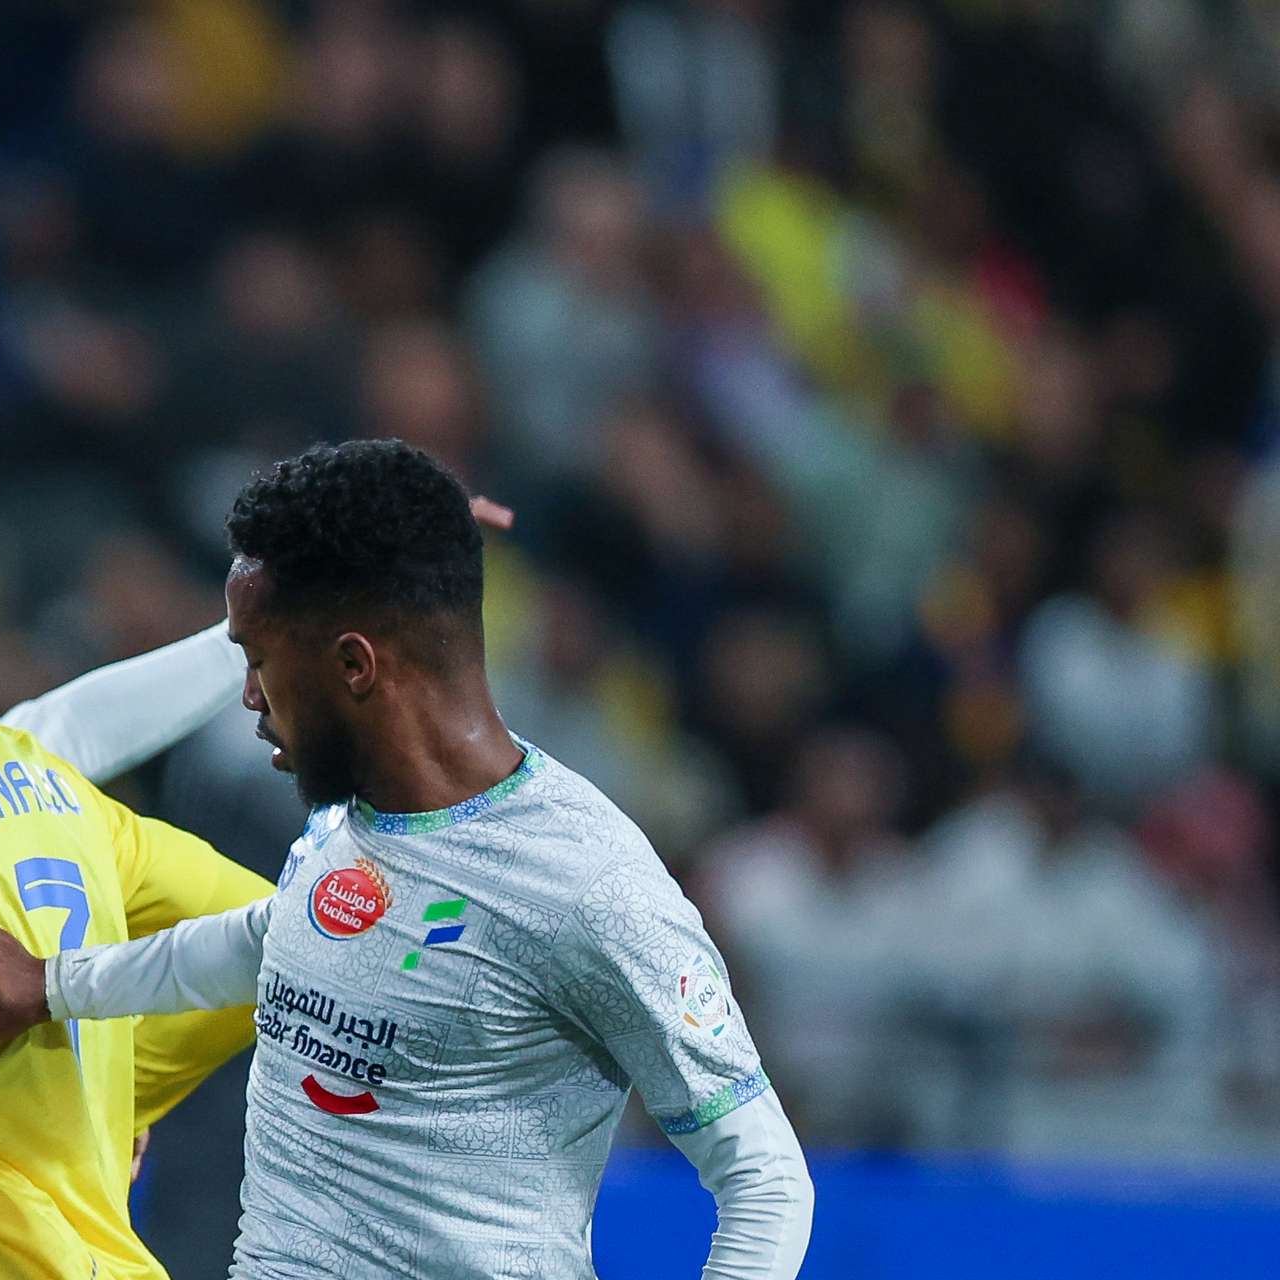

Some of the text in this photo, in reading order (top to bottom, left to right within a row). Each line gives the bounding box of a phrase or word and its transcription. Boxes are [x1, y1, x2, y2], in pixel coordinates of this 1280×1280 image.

[13, 857, 90, 1020] 7
[697, 984, 716, 1007] RSL
[291, 1023, 388, 1085] finance
[331, 1012, 398, 1050] الجبر
